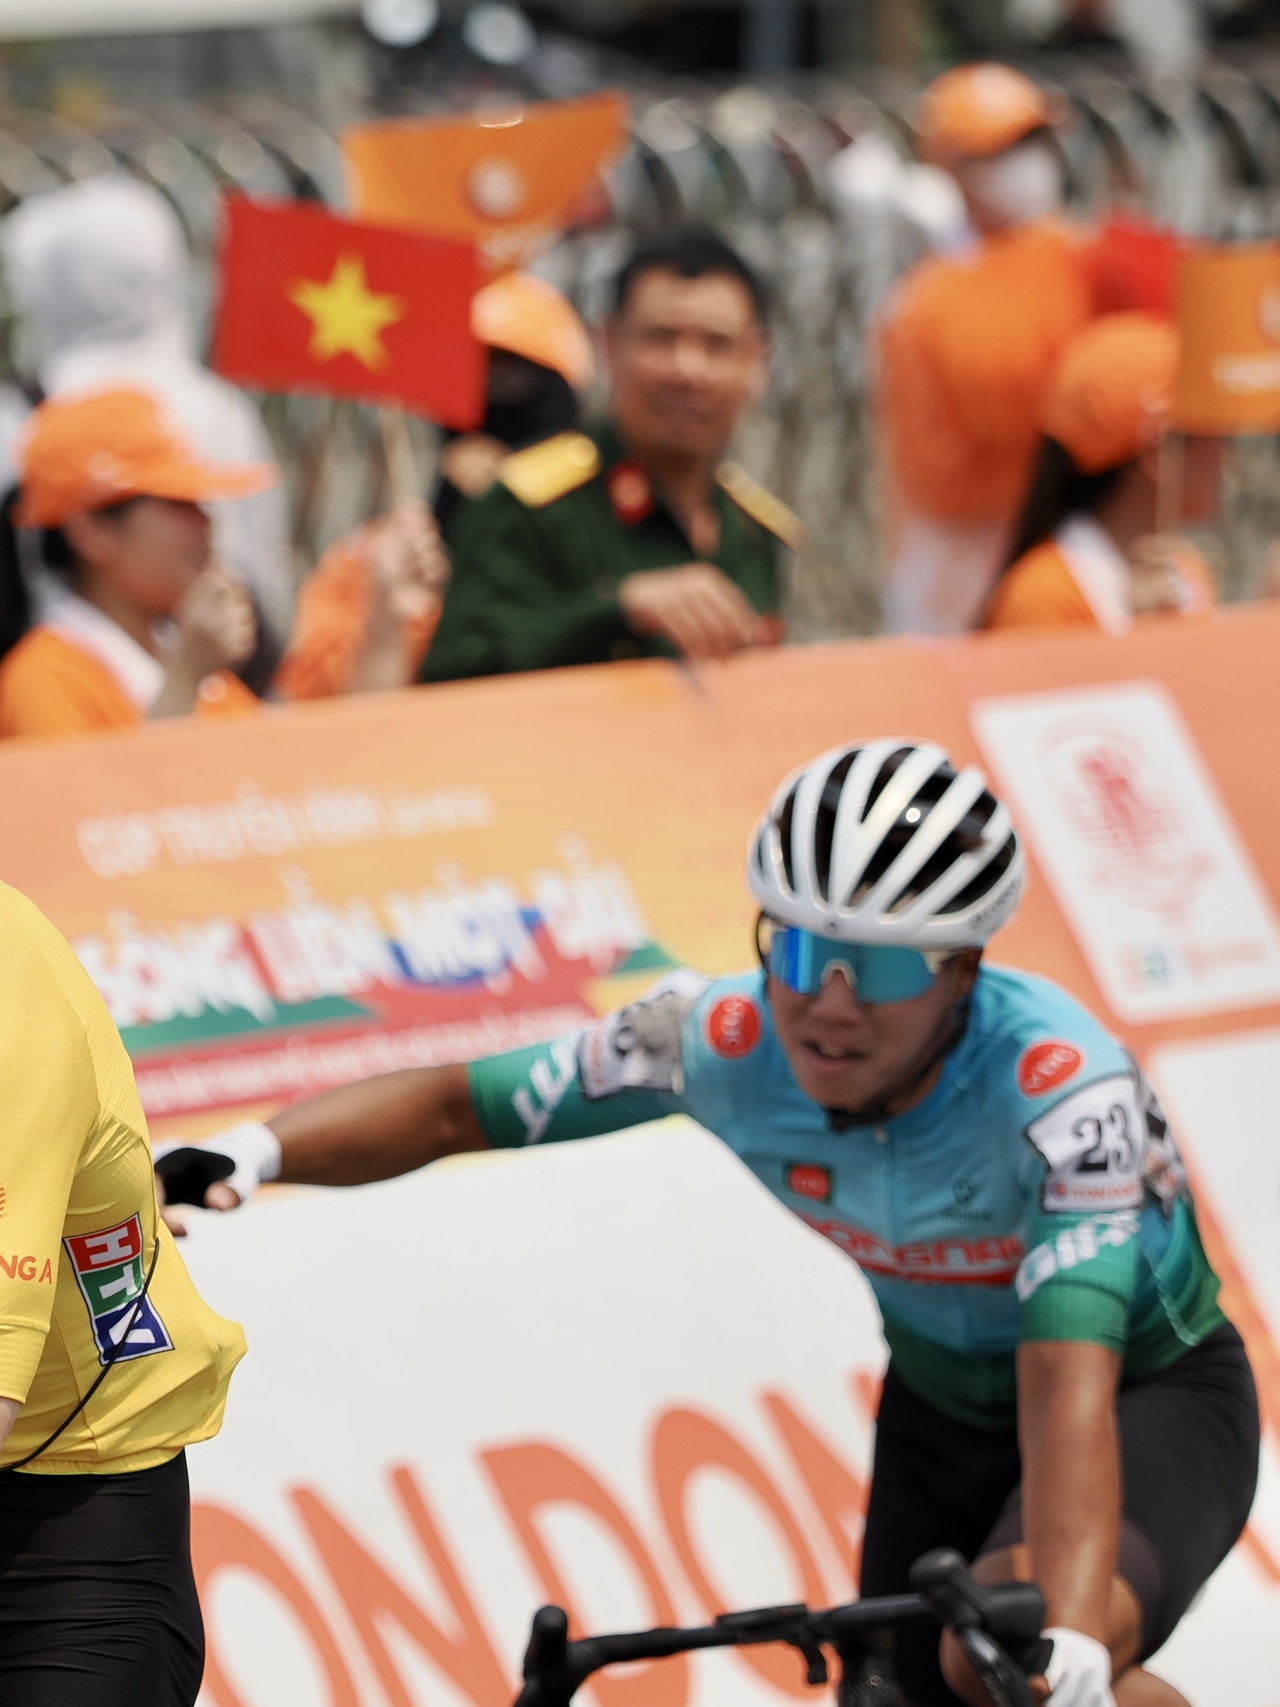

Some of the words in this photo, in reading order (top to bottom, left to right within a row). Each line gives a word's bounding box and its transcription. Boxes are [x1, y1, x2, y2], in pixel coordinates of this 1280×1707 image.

[1072, 1102, 1134, 1175] 23
[38, 1258, 52, 1285] A
[80, 1222, 160, 1349] HTV
